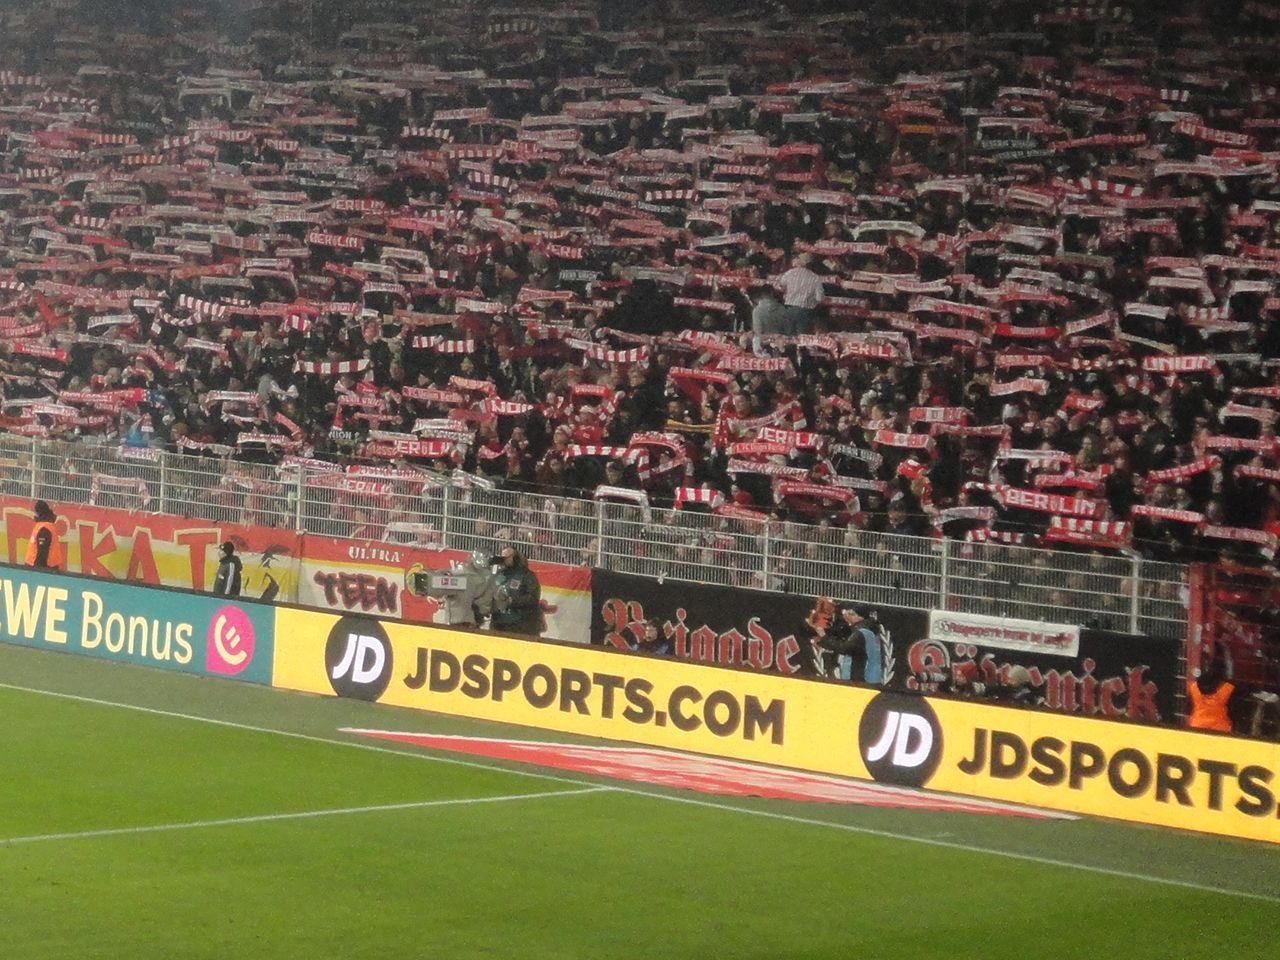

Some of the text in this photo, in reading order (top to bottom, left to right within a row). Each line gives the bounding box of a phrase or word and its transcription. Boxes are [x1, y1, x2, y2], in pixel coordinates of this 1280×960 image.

[1007, 489, 1097, 516] BERLIN
[313, 570, 398, 614] TEEN
[81, 591, 194, 665] Bonus
[333, 632, 387, 685] JD
[403, 646, 786, 746] JDSPORTS.COM
[868, 710, 934, 769] JD
